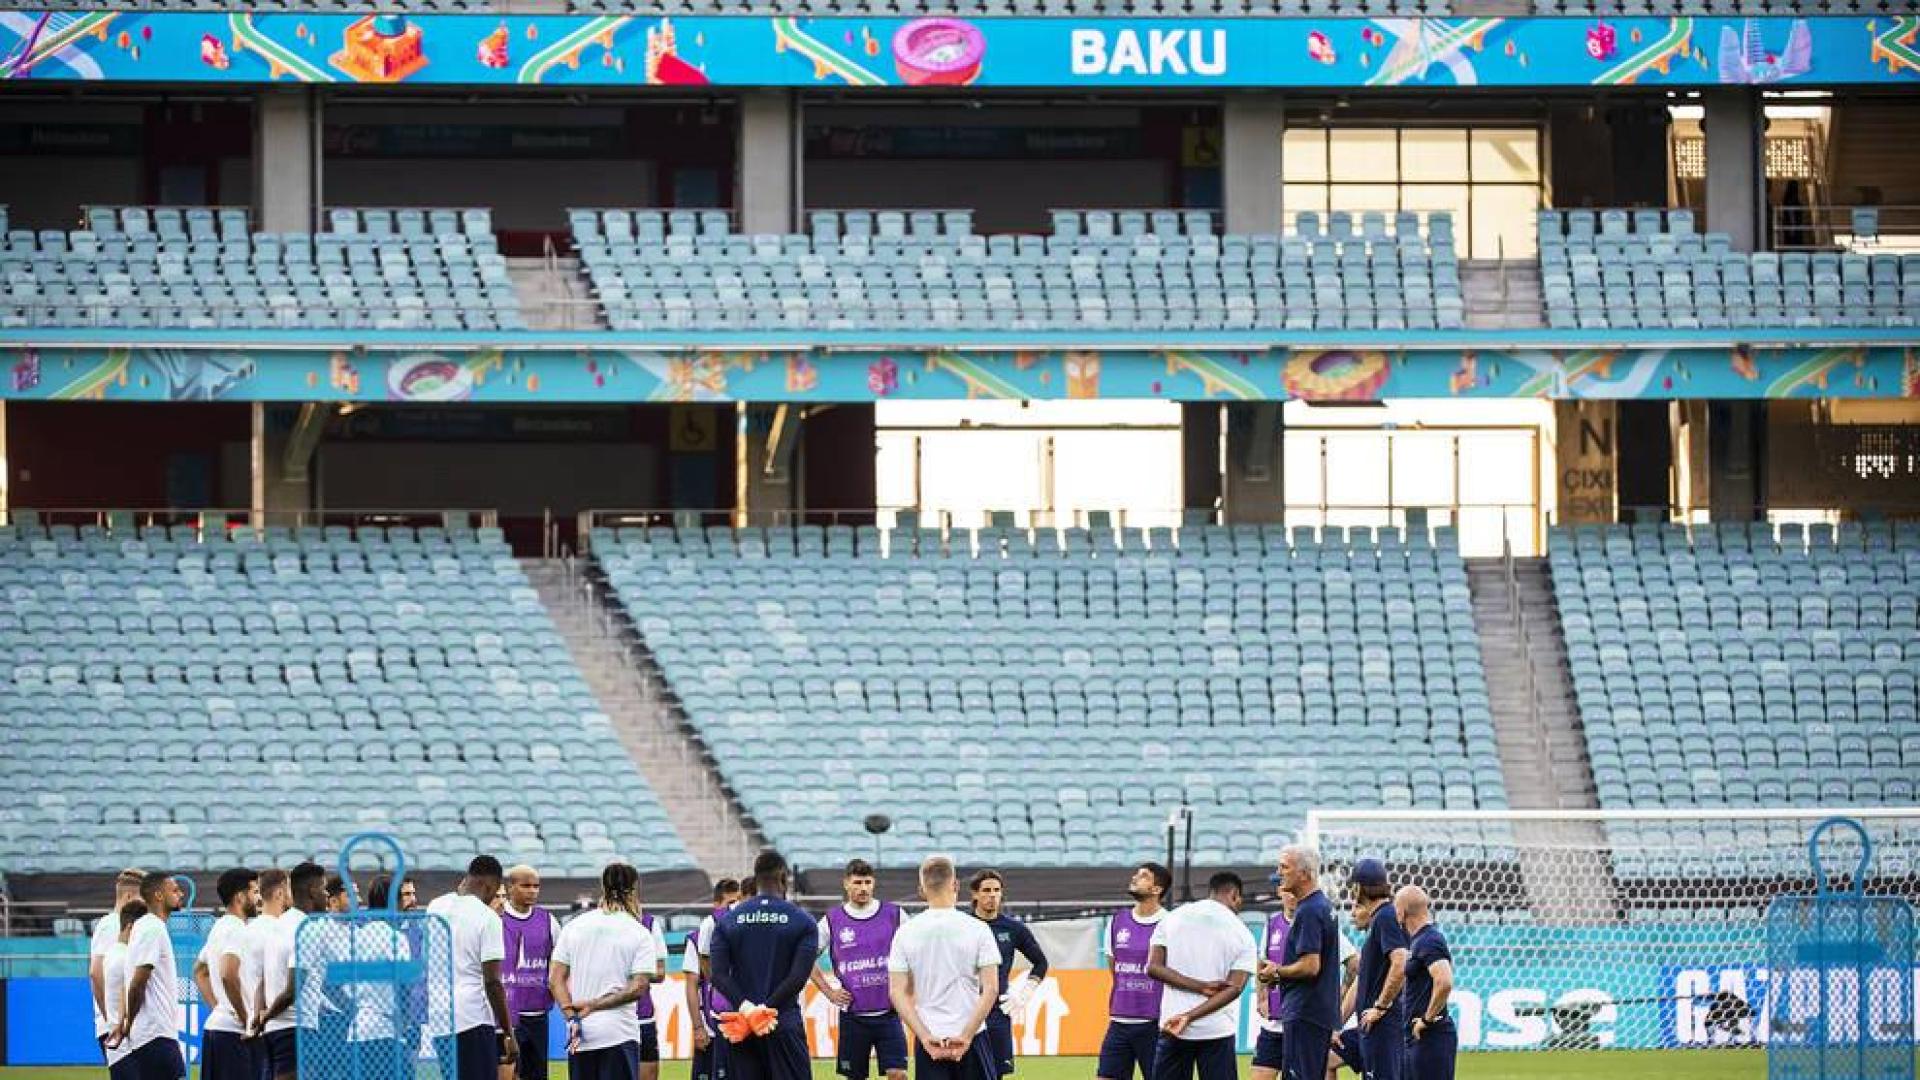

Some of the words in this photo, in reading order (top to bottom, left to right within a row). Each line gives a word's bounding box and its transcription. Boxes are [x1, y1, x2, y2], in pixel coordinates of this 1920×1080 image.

[1071, 28, 1227, 75] BAKU
[1579, 418, 1612, 456] N
[736, 910, 788, 924] suisse
[1675, 968, 1920, 1046] GAZPRO
